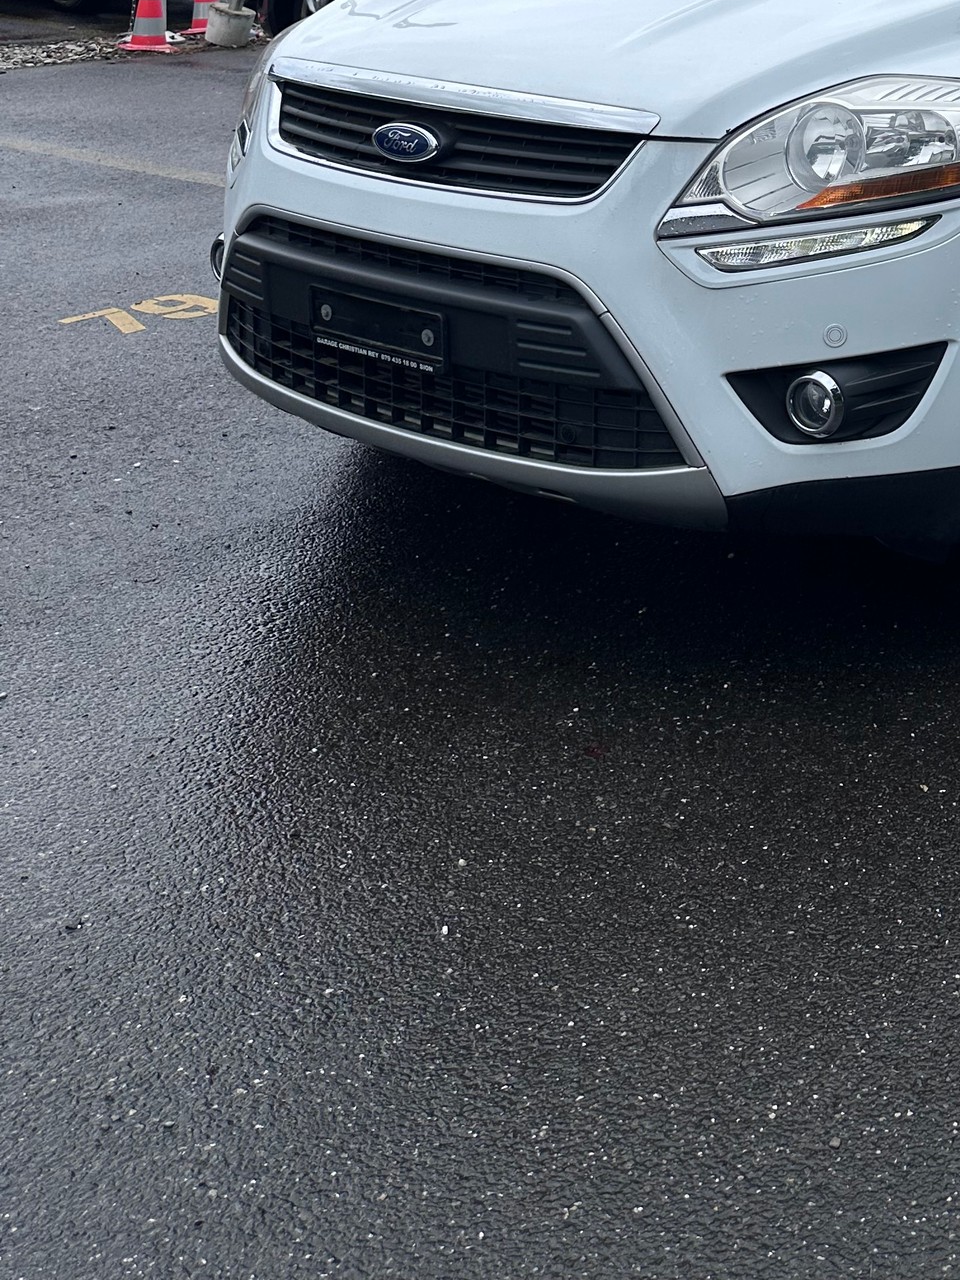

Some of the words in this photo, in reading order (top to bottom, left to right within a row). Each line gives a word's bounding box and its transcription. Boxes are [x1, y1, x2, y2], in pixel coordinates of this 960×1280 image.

[384, 130, 418, 153] Ford
[58, 293, 219, 334] 79
[339, 343, 367, 355] CHRISTIAN
[368, 350, 379, 358] REY
[381, 354, 391, 362] 079
